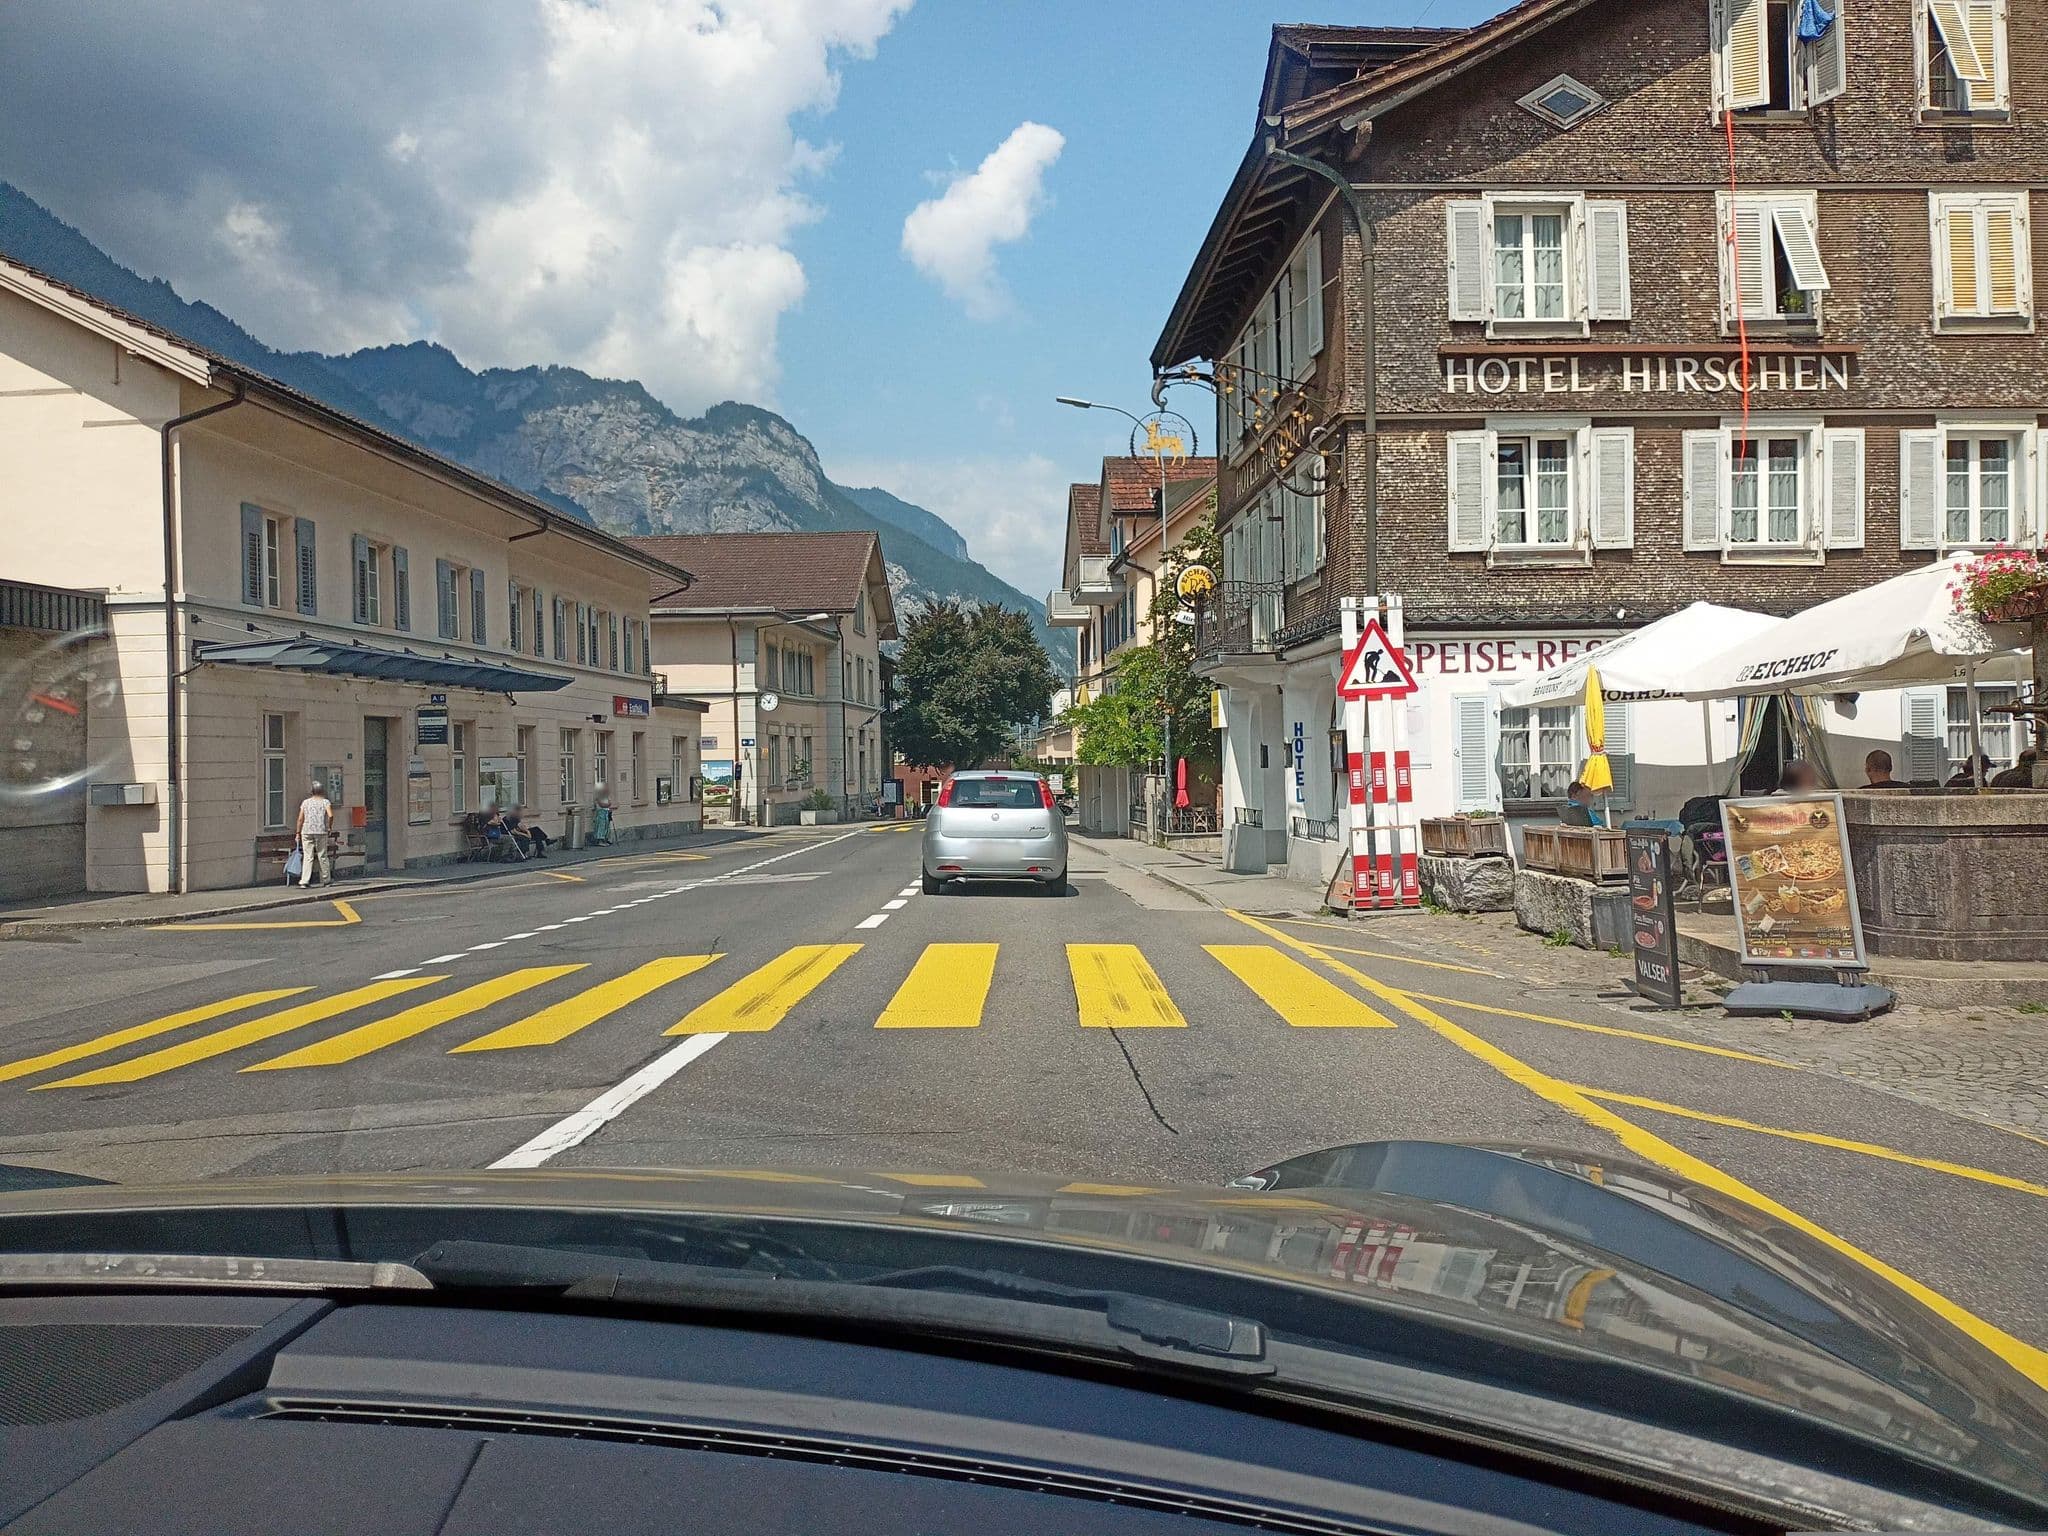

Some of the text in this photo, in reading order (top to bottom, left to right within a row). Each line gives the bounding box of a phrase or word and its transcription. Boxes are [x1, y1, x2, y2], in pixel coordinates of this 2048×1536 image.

[1446, 355, 1849, 394] HOTEL HIRSCHEN
[1236, 455, 1260, 498] HOTEL
[1750, 648, 1839, 680] EICHHOF
[1294, 721, 1305, 802] HOTEL
[1638, 959, 1667, 984] VALSER
